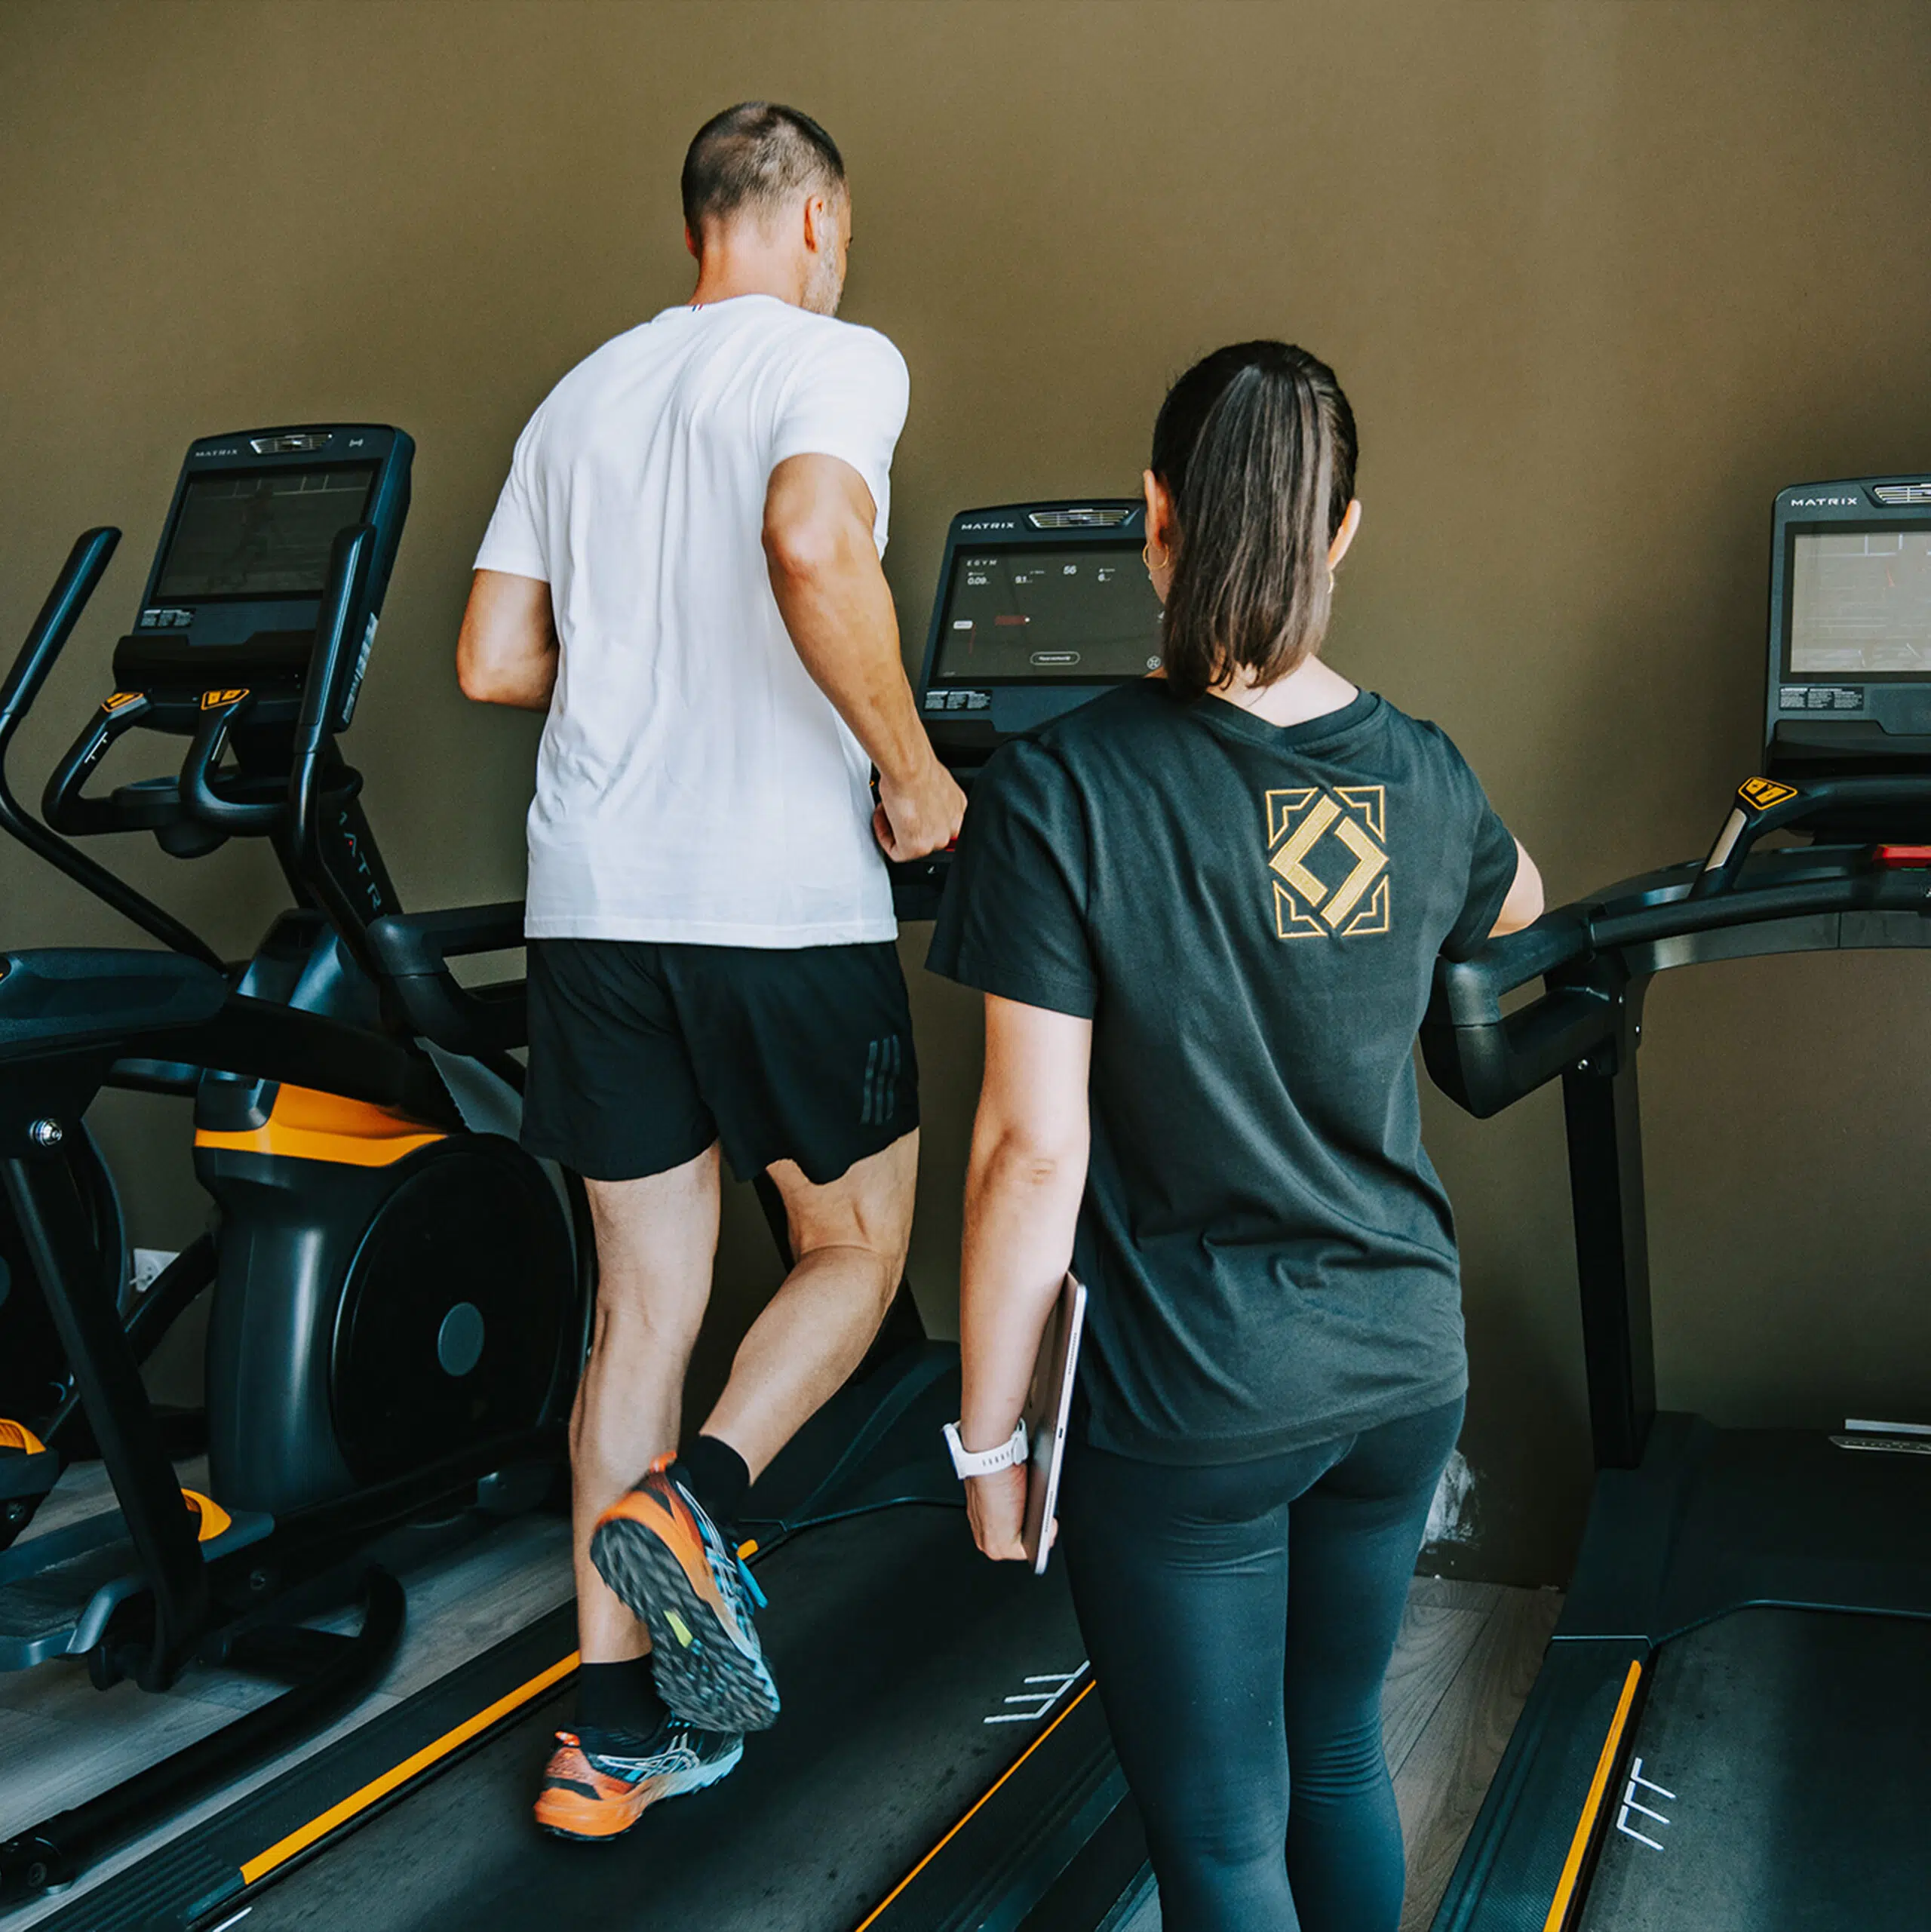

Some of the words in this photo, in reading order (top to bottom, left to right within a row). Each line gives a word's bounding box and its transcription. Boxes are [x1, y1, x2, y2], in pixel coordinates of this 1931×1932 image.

[195, 448, 238, 457] MATRIX
[1791, 496, 1858, 507] MATRIX
[961, 522, 1015, 530] MATRIX
